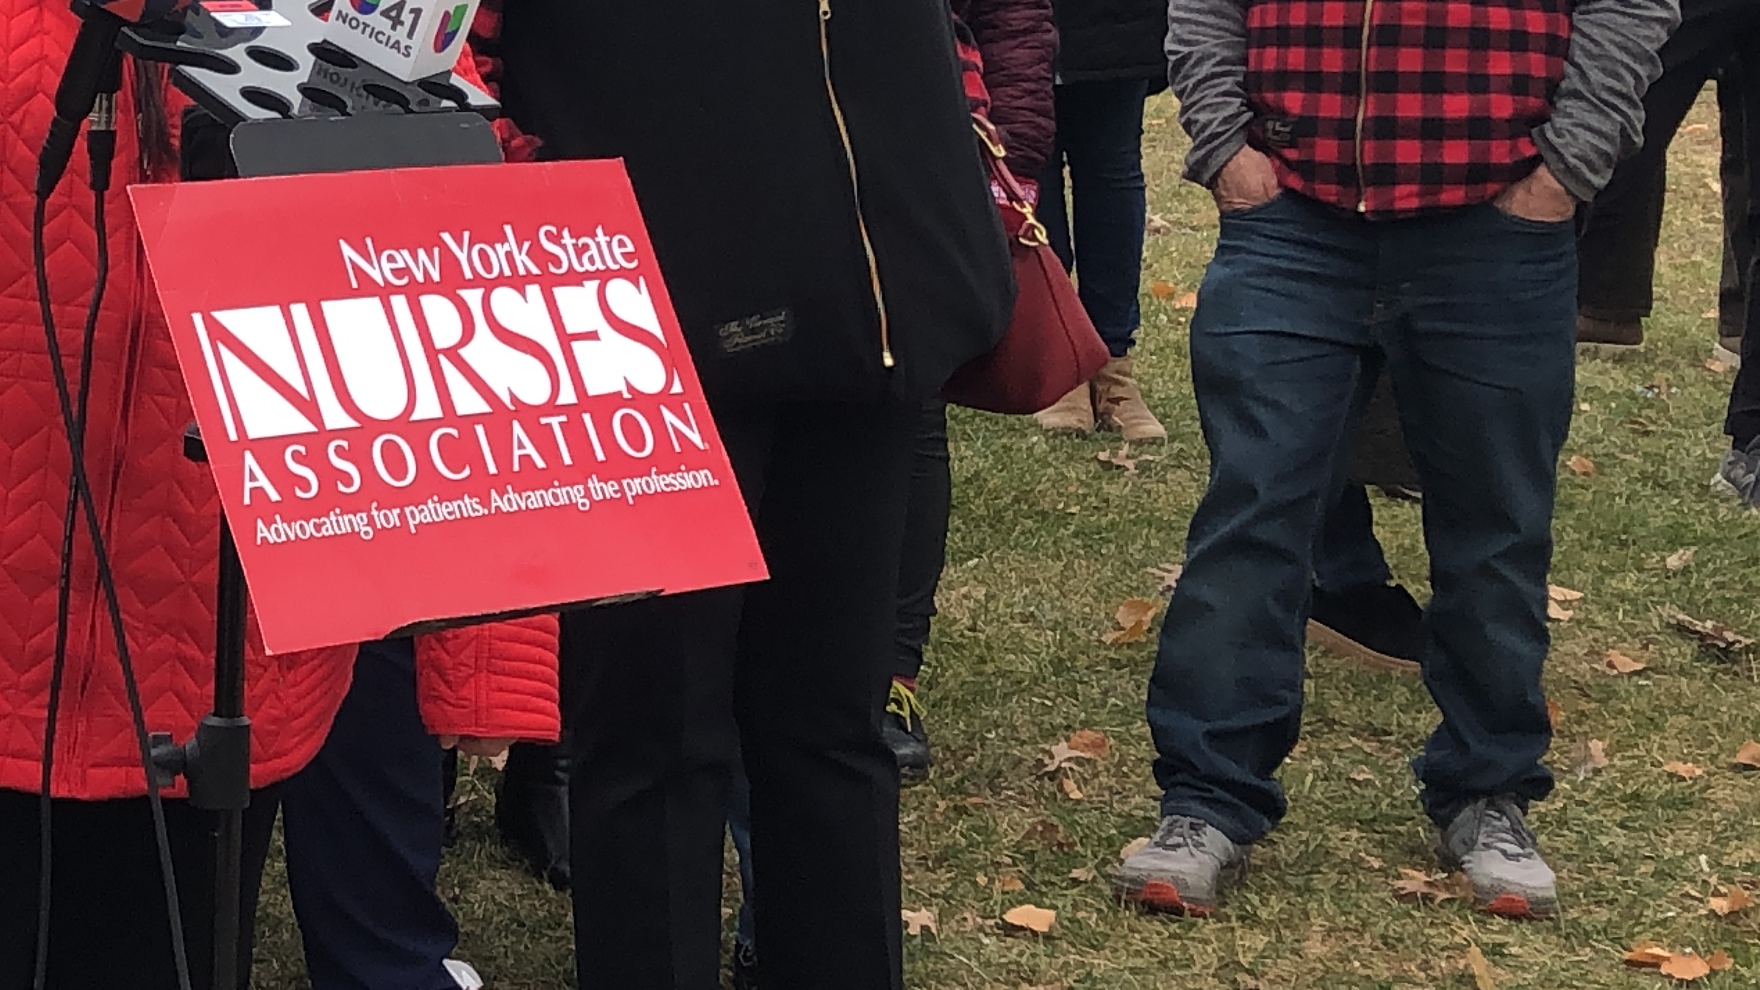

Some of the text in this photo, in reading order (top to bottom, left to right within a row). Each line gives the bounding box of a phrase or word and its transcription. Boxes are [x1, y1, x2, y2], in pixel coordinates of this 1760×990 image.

[335, 9, 413, 59] NOTICIAS
[338, 222, 640, 290] New York State
[190, 275, 685, 443] NURSES
[242, 401, 706, 506] ASSOCIATION
[254, 463, 720, 547] Advocating for patients. Advancing the profession.
